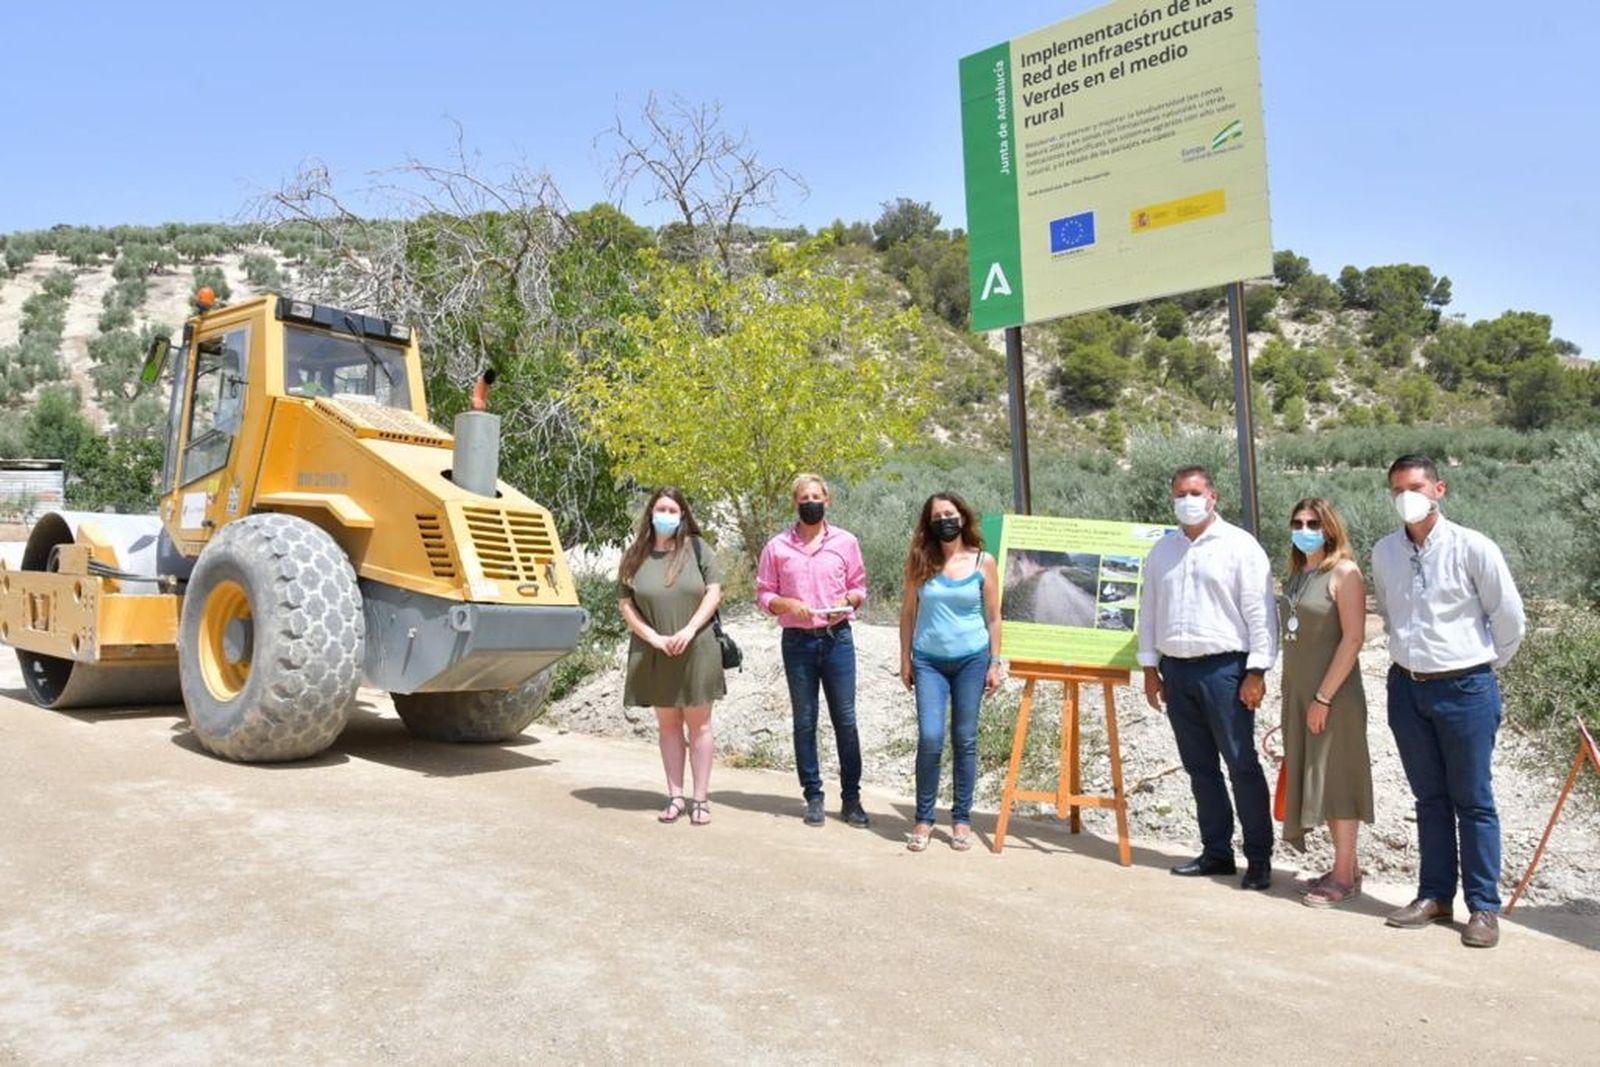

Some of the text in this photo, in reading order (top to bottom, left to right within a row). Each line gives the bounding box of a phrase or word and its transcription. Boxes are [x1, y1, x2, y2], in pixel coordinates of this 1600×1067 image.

[1020, 0, 1190, 68] Implementación de
[1022, 6, 1234, 88] Red de Infraestructuras
[1022, 43, 1189, 108] Verdes en el medio
[992, 59, 1010, 176] Junta de Andalucía
[1023, 101, 1065, 129] rural
